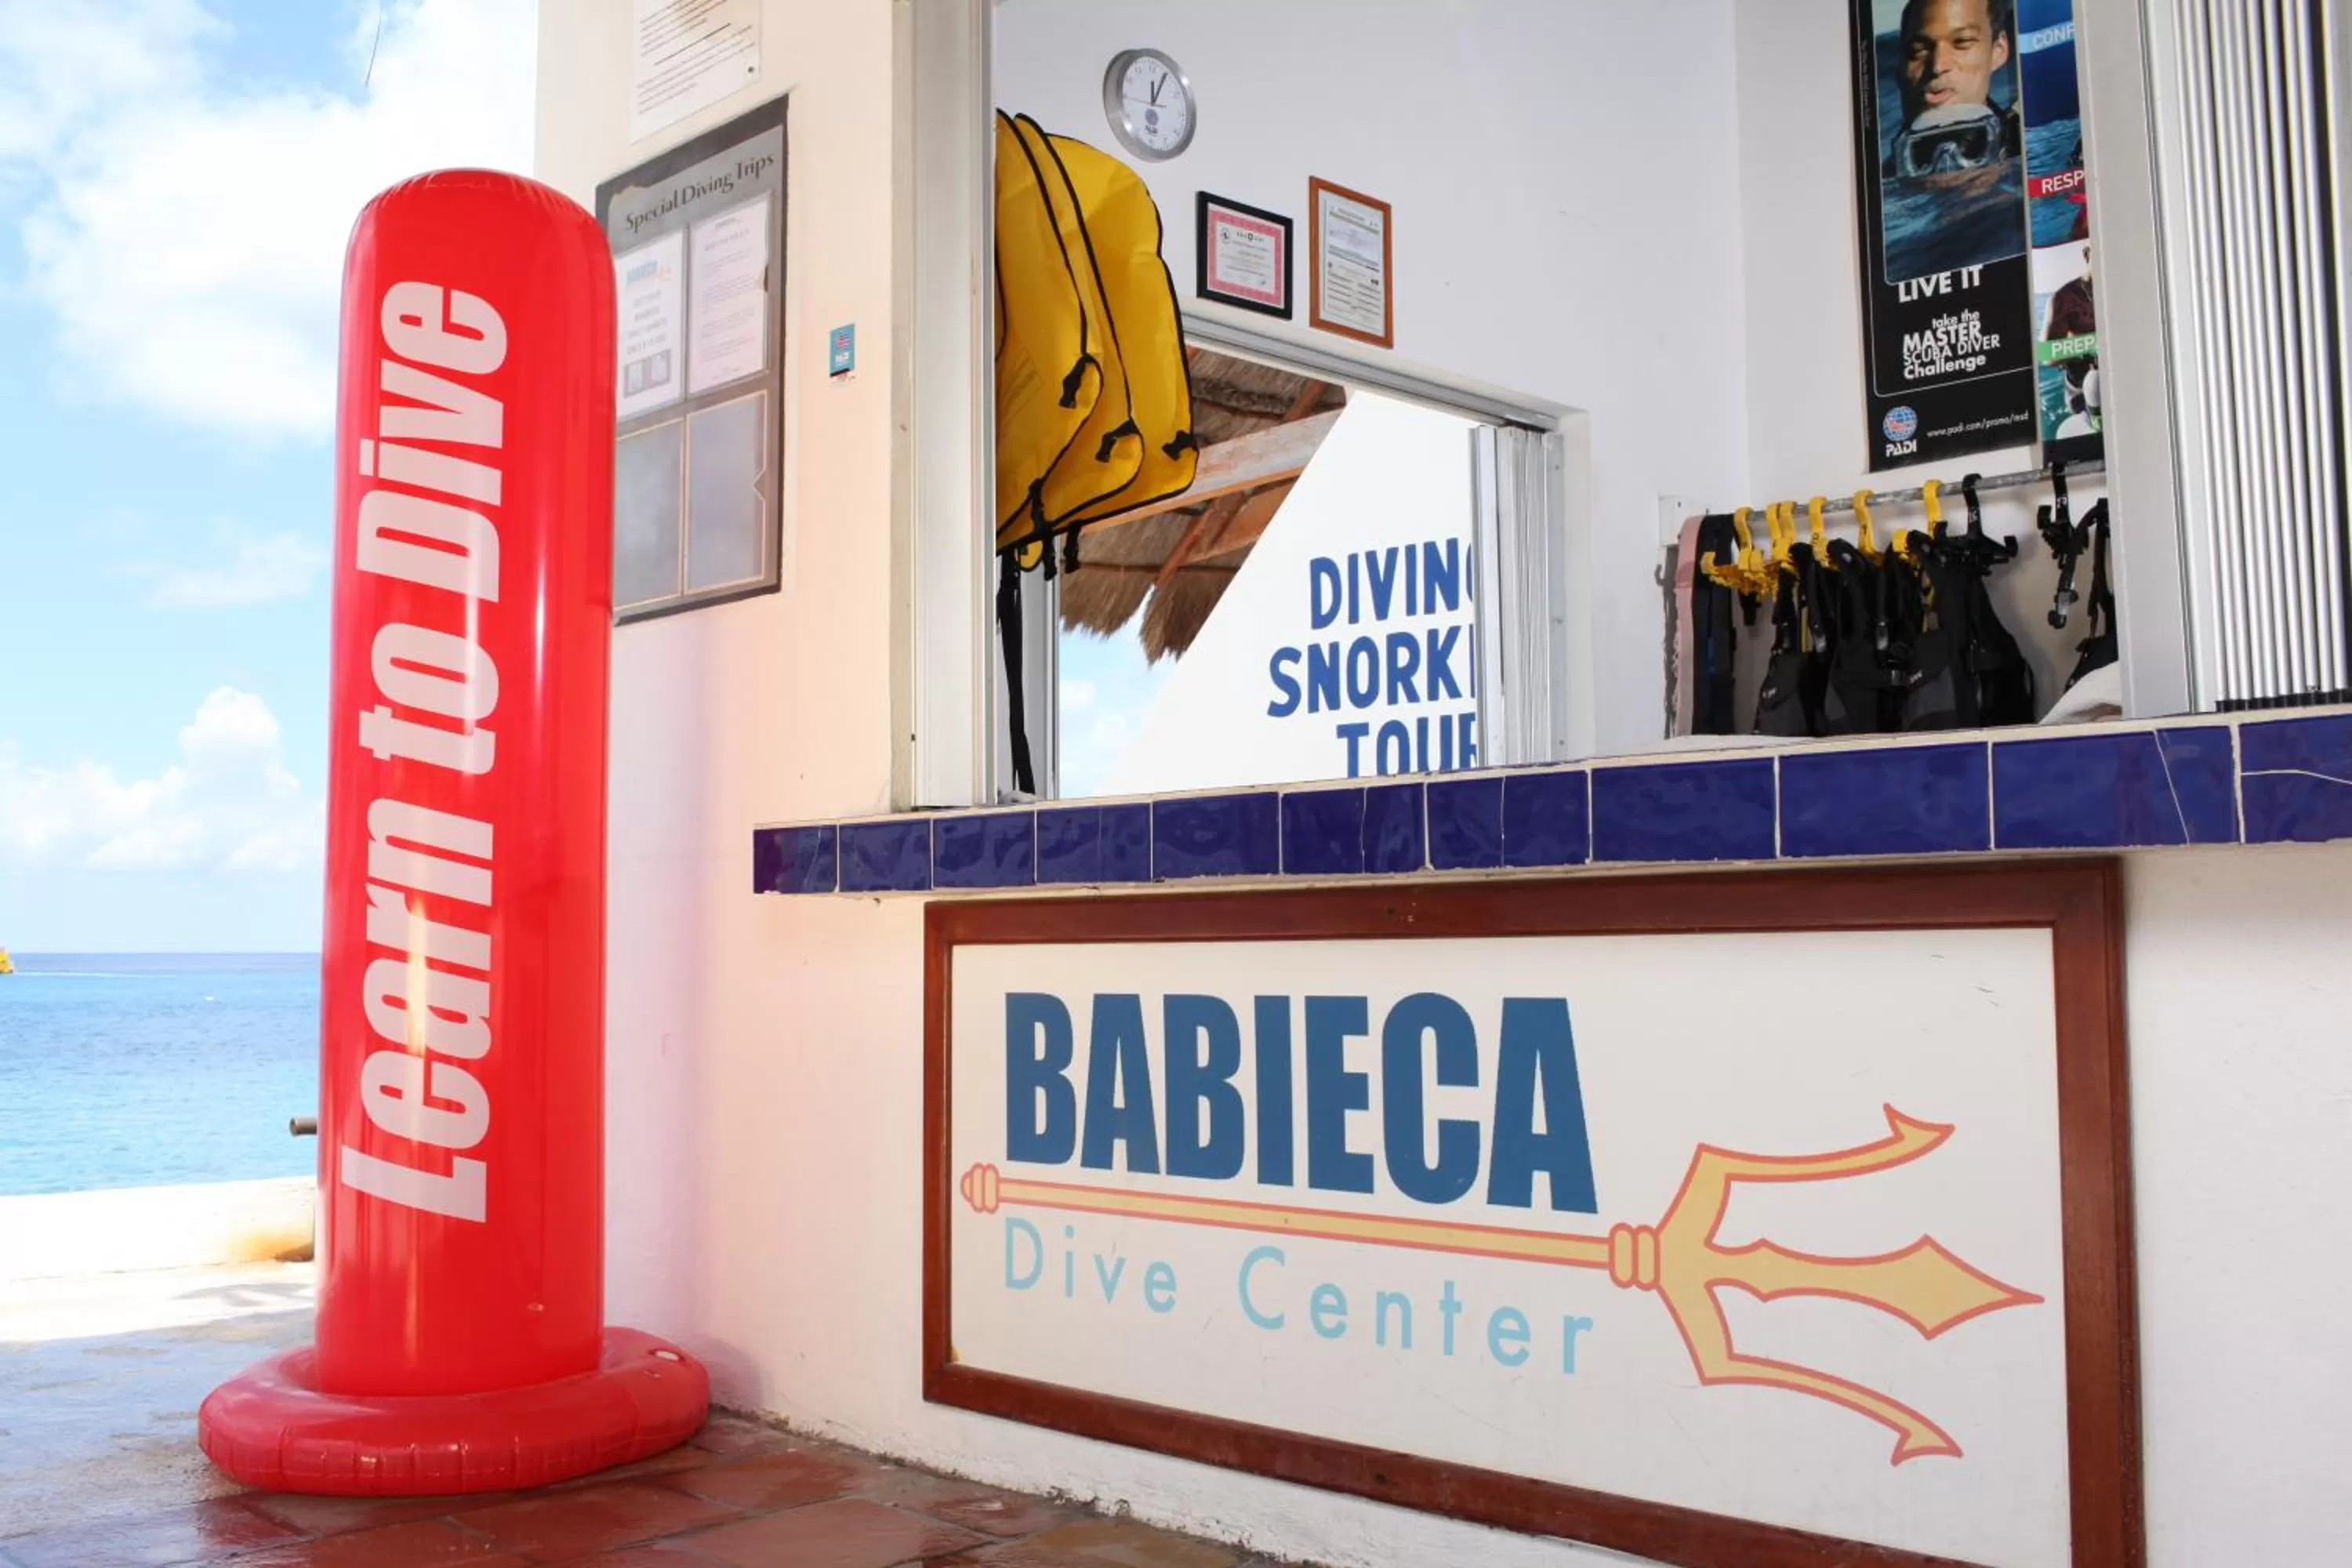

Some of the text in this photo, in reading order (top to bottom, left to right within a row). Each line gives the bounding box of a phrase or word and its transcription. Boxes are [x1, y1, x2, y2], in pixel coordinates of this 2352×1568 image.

[625, 155, 775, 234] Special Diving Trips
[2042, 170, 2084, 194] RESP
[1898, 263, 1984, 303] LIVE IT
[1903, 321, 1983, 353] MASTER
[1932, 308, 1980, 329] take the
[1904, 334, 2000, 366] SCUBA DIVER
[1904, 354, 1986, 380] Challenge
[1886, 439, 1917, 458] PADI
[1309, 537, 1473, 630] DIVIN
[1267, 623, 1475, 717] SNORK
[341, 281, 508, 1223] Learn to Dive
[1005, 992, 1599, 1214] BABIECA
[1004, 1218, 1594, 1374] Dive Center
